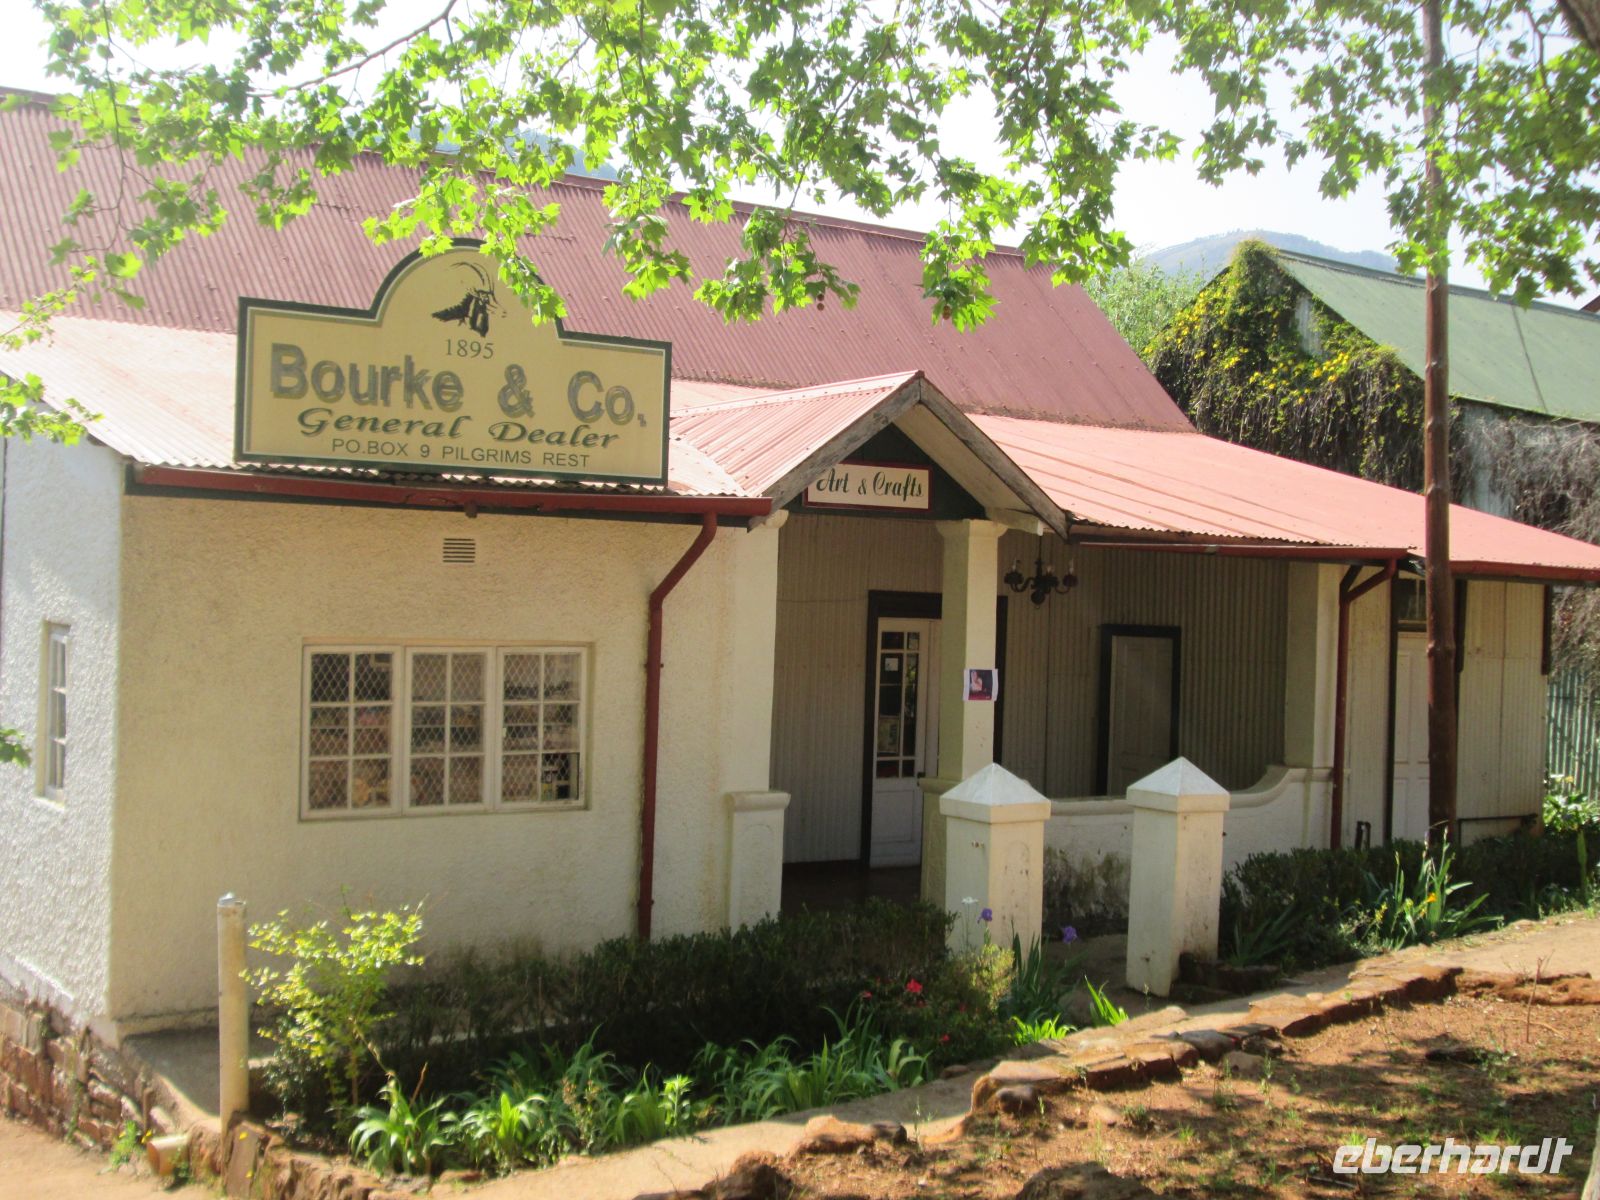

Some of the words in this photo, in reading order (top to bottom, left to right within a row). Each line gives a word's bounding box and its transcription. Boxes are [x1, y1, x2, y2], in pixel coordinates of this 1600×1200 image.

[444, 337, 494, 360] 1895
[270, 342, 464, 412] Bourke
[497, 363, 533, 418] &
[566, 369, 647, 428] Co.
[297, 407, 471, 440] General
[488, 421, 619, 449] Dealer
[420, 444, 430, 458] 9
[442, 446, 532, 465] PILGRIMS
[543, 453, 590, 468] REST
[816, 468, 849, 493] Art
[858, 478, 867, 495] &
[873, 471, 922, 502] Crafts
